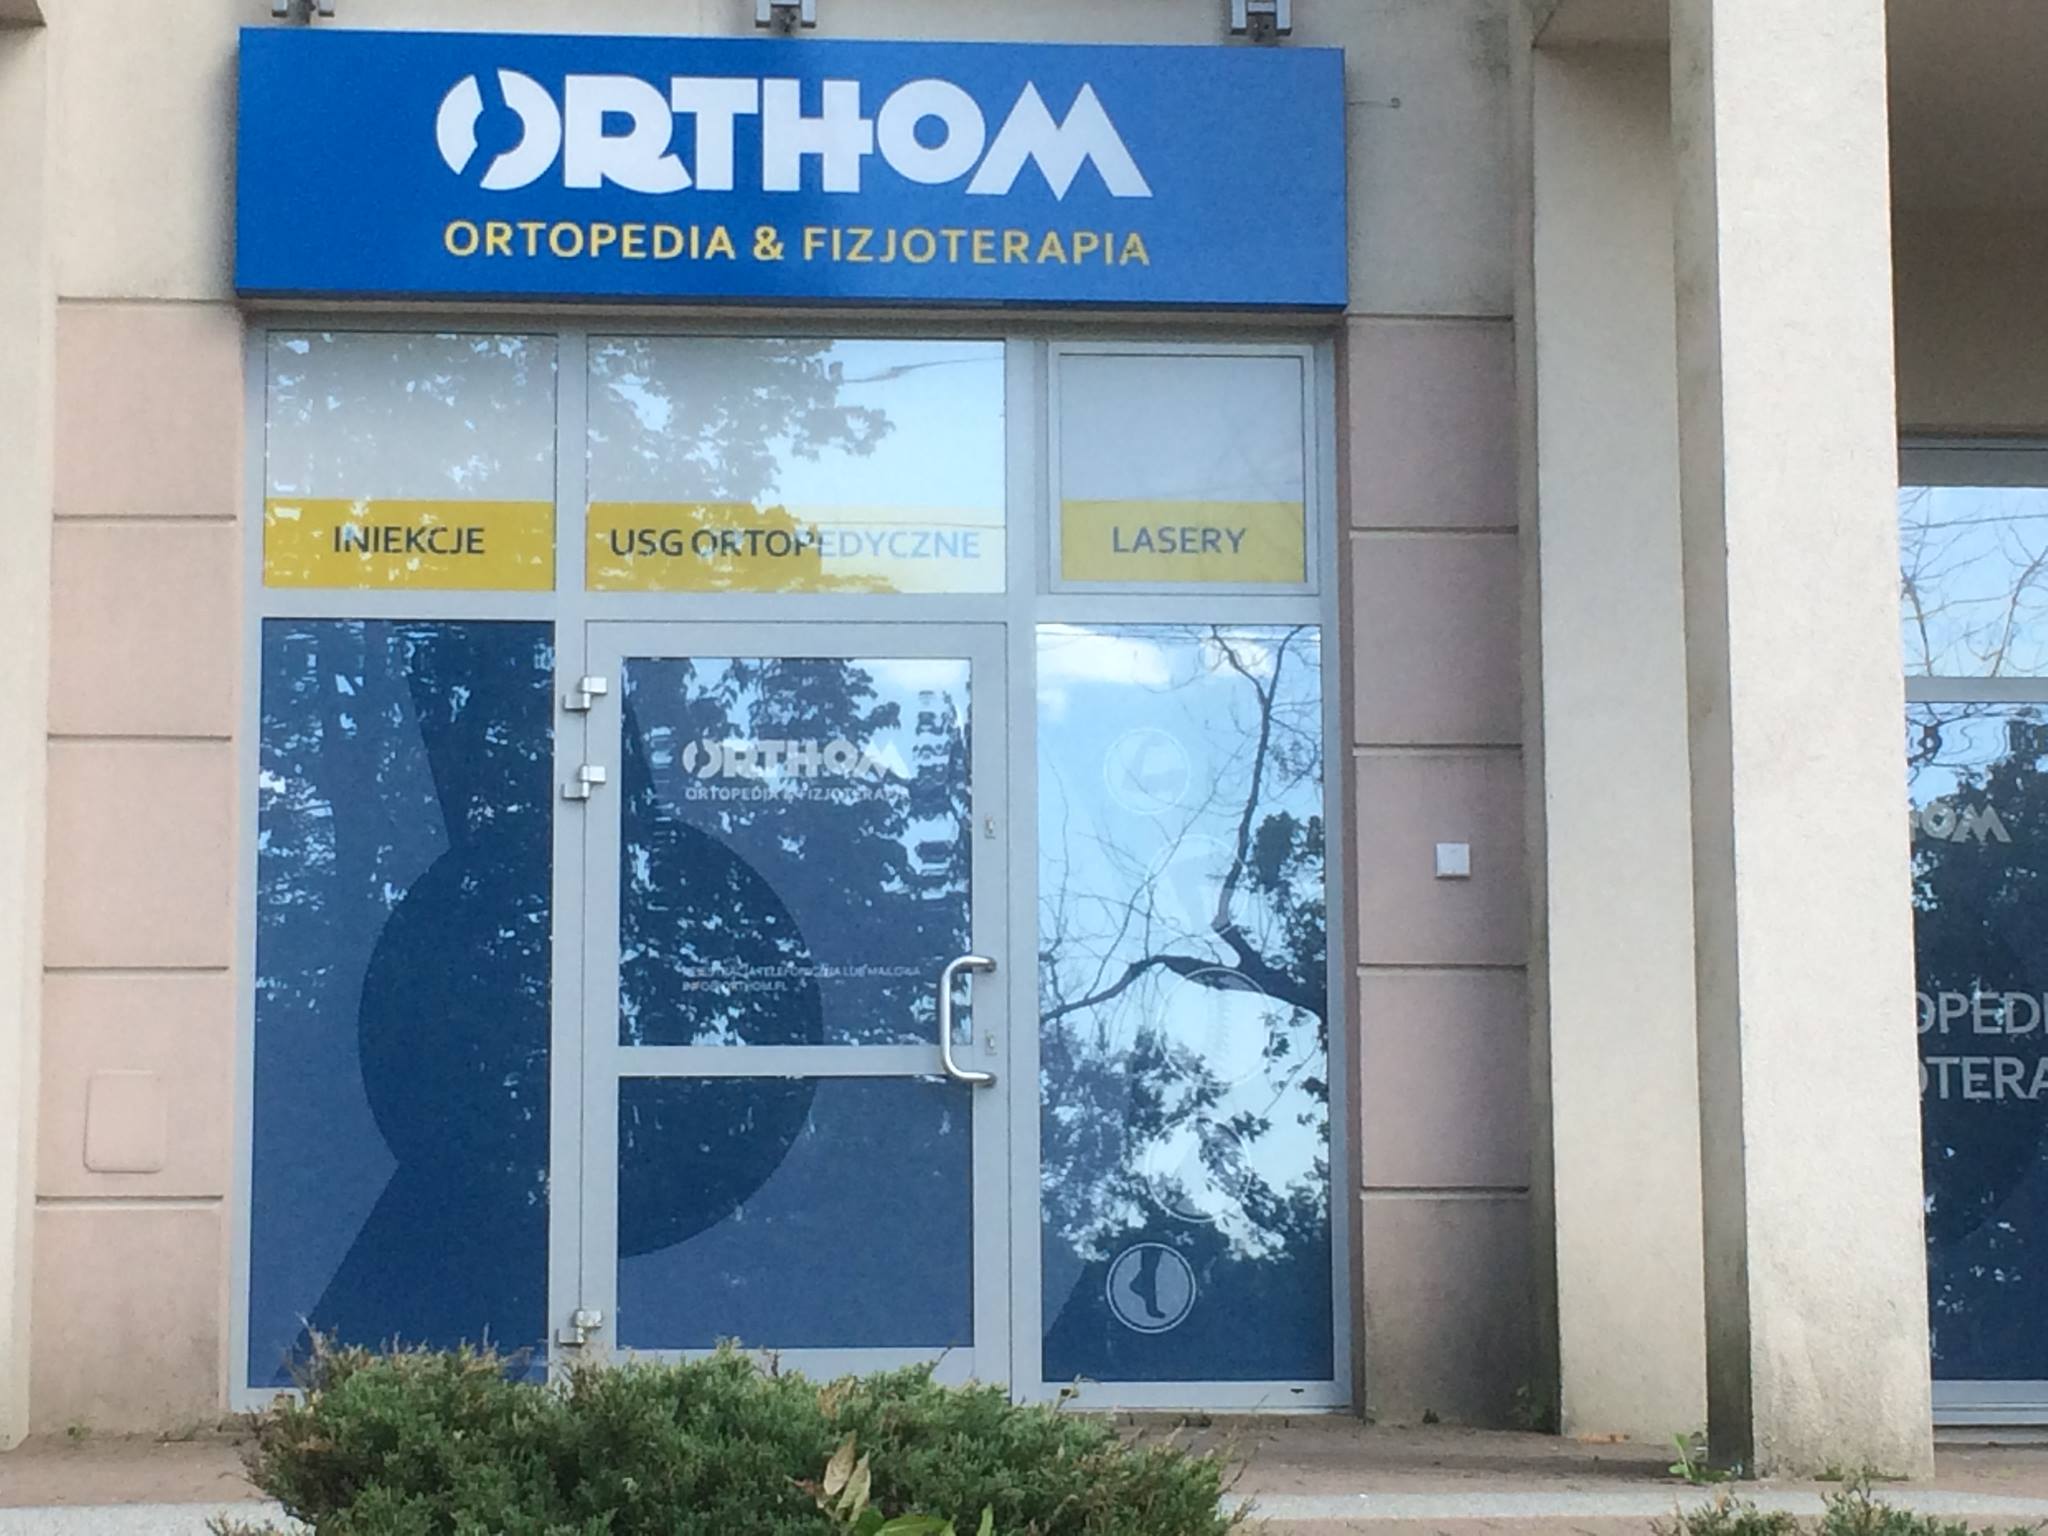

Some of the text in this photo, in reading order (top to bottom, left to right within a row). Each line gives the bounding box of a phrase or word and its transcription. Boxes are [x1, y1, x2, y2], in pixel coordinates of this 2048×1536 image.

[436, 68, 1152, 201] ORTHOM
[444, 220, 1150, 266] ORTOPEDIA & FIZJOTERAPIA
[334, 525, 485, 554] INIEKCJE
[610, 528, 981, 559] USG ORTOPEDYCZNE
[1113, 526, 1247, 553] LASERY
[682, 738, 911, 780] ORTHOM
[1910, 802, 2012, 843] OM
[1919, 1056, 2048, 1100] TERA
